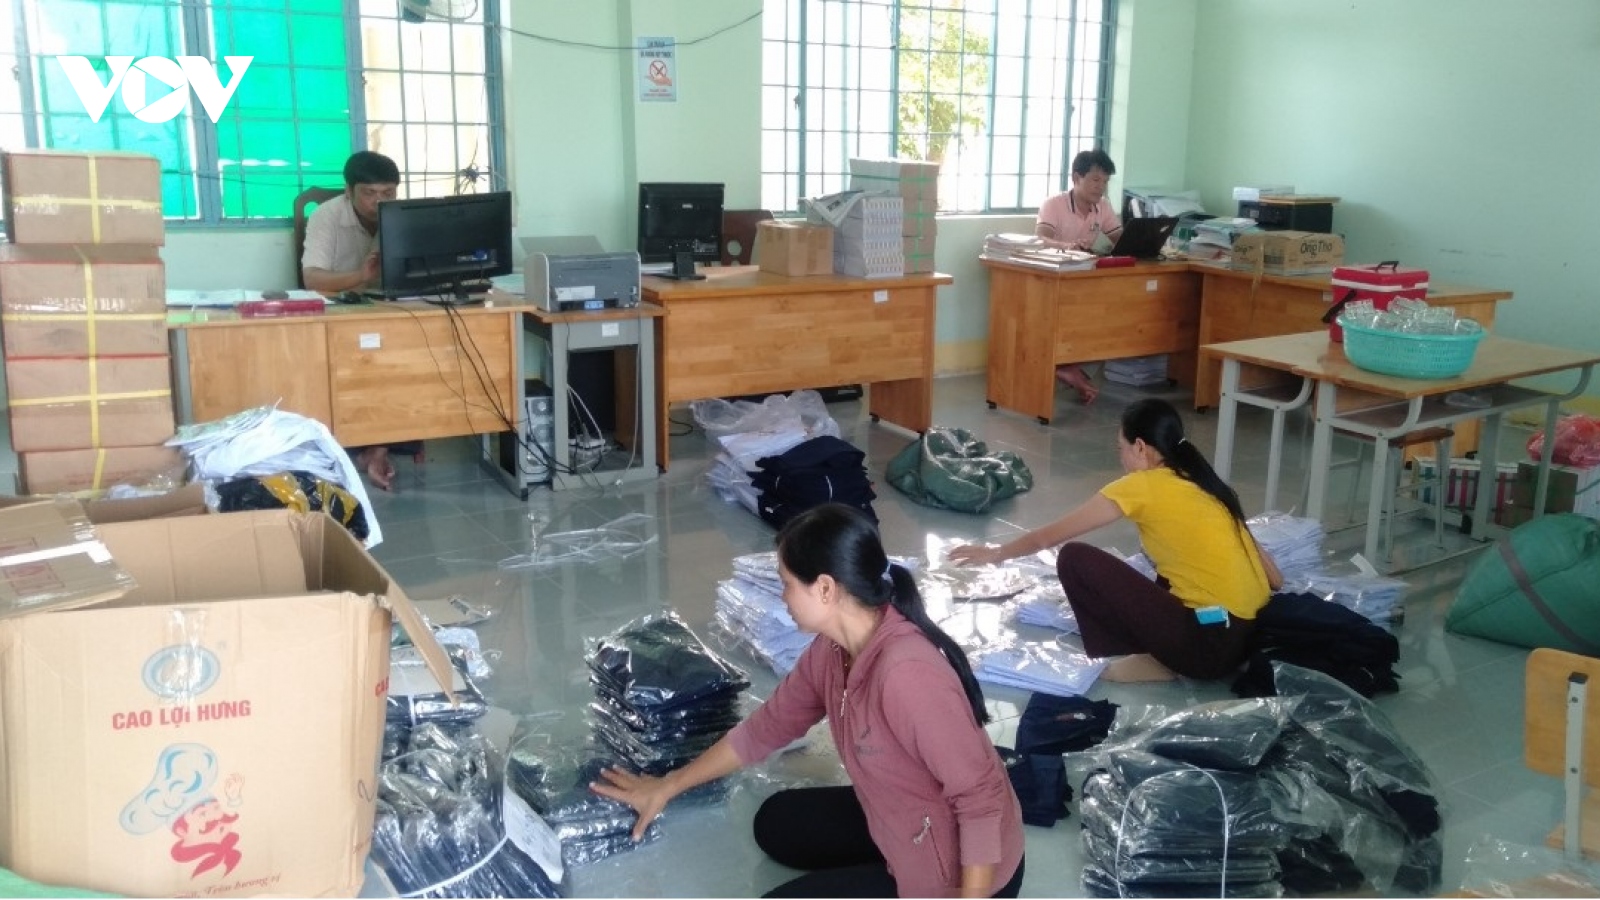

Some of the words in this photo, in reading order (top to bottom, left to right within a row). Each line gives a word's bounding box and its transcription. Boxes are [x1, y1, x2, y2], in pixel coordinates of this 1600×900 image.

[112, 710, 152, 730] CAO
[160, 706, 190, 728] LỢI
[197, 700, 252, 721] HƯNG
